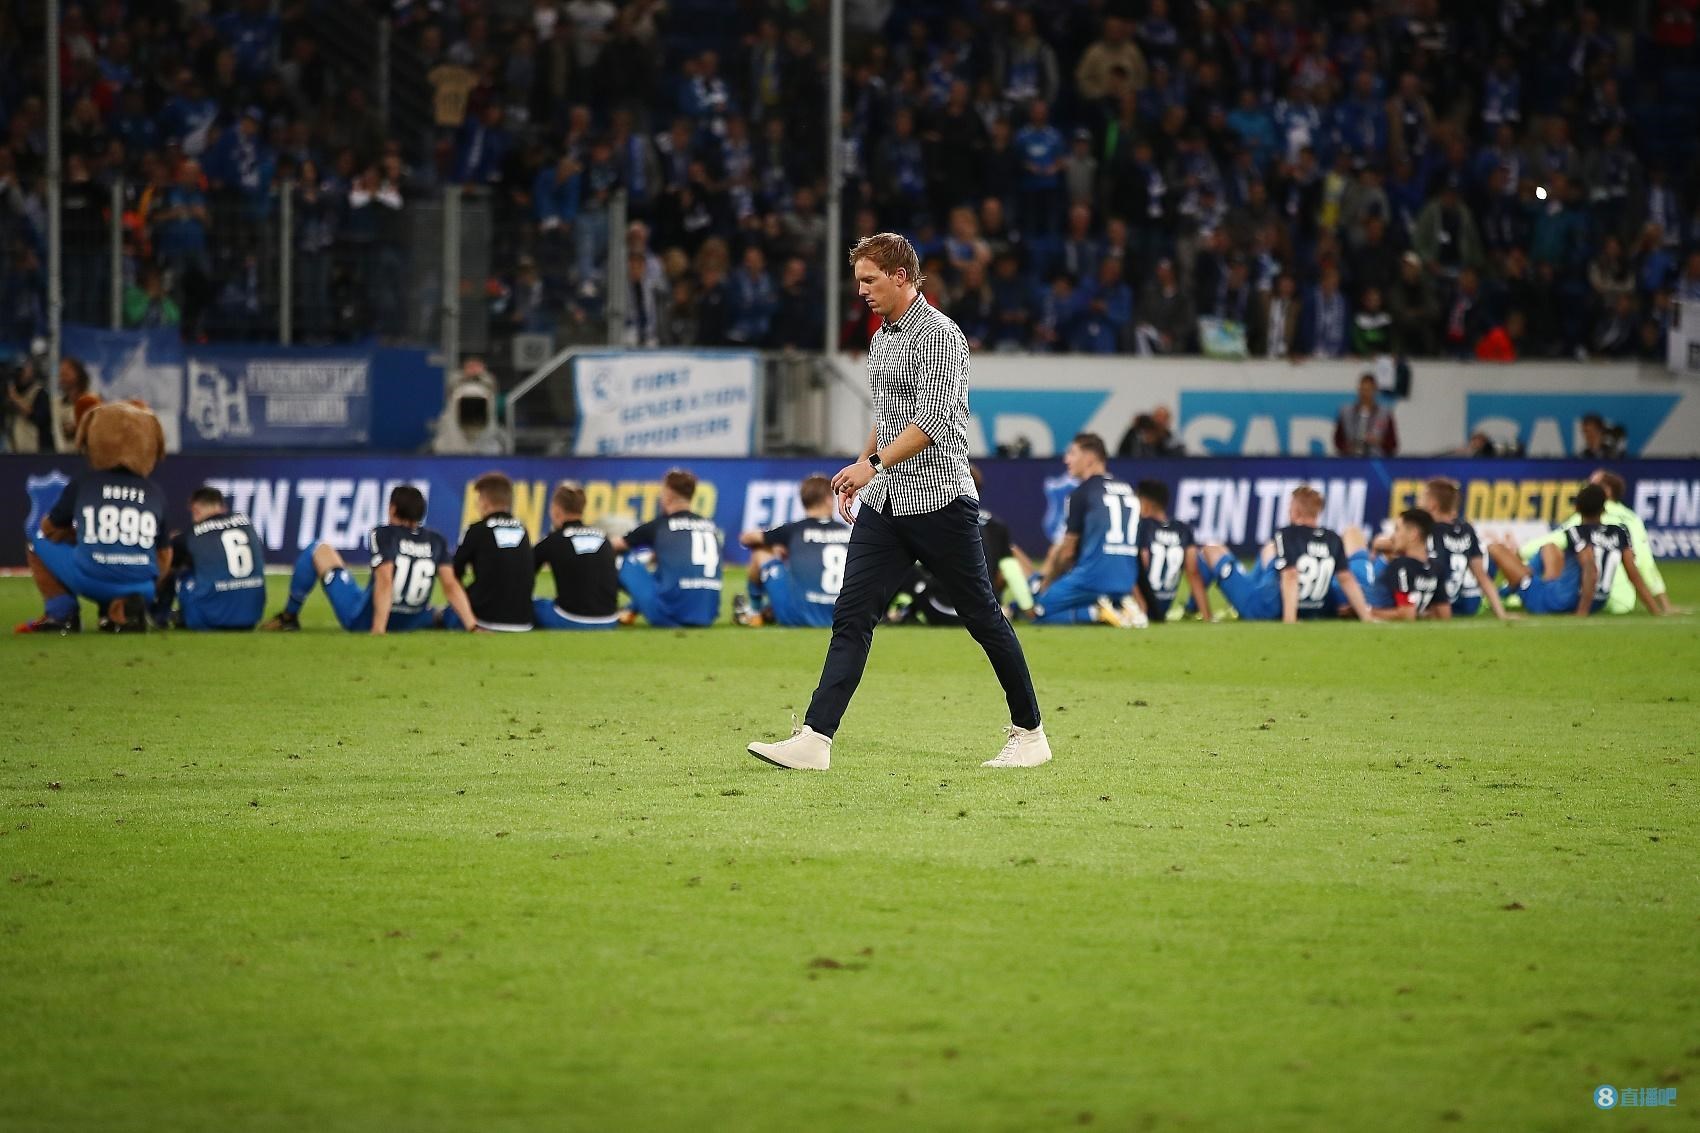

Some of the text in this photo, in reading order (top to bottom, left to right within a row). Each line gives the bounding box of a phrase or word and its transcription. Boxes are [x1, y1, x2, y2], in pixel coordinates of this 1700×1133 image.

[82, 504, 158, 549] 1899
[1102, 493, 1141, 546] 17
[220, 528, 255, 579] 6
[690, 530, 720, 578] 4
[820, 543, 850, 595] 8
[392, 555, 436, 606] 16
